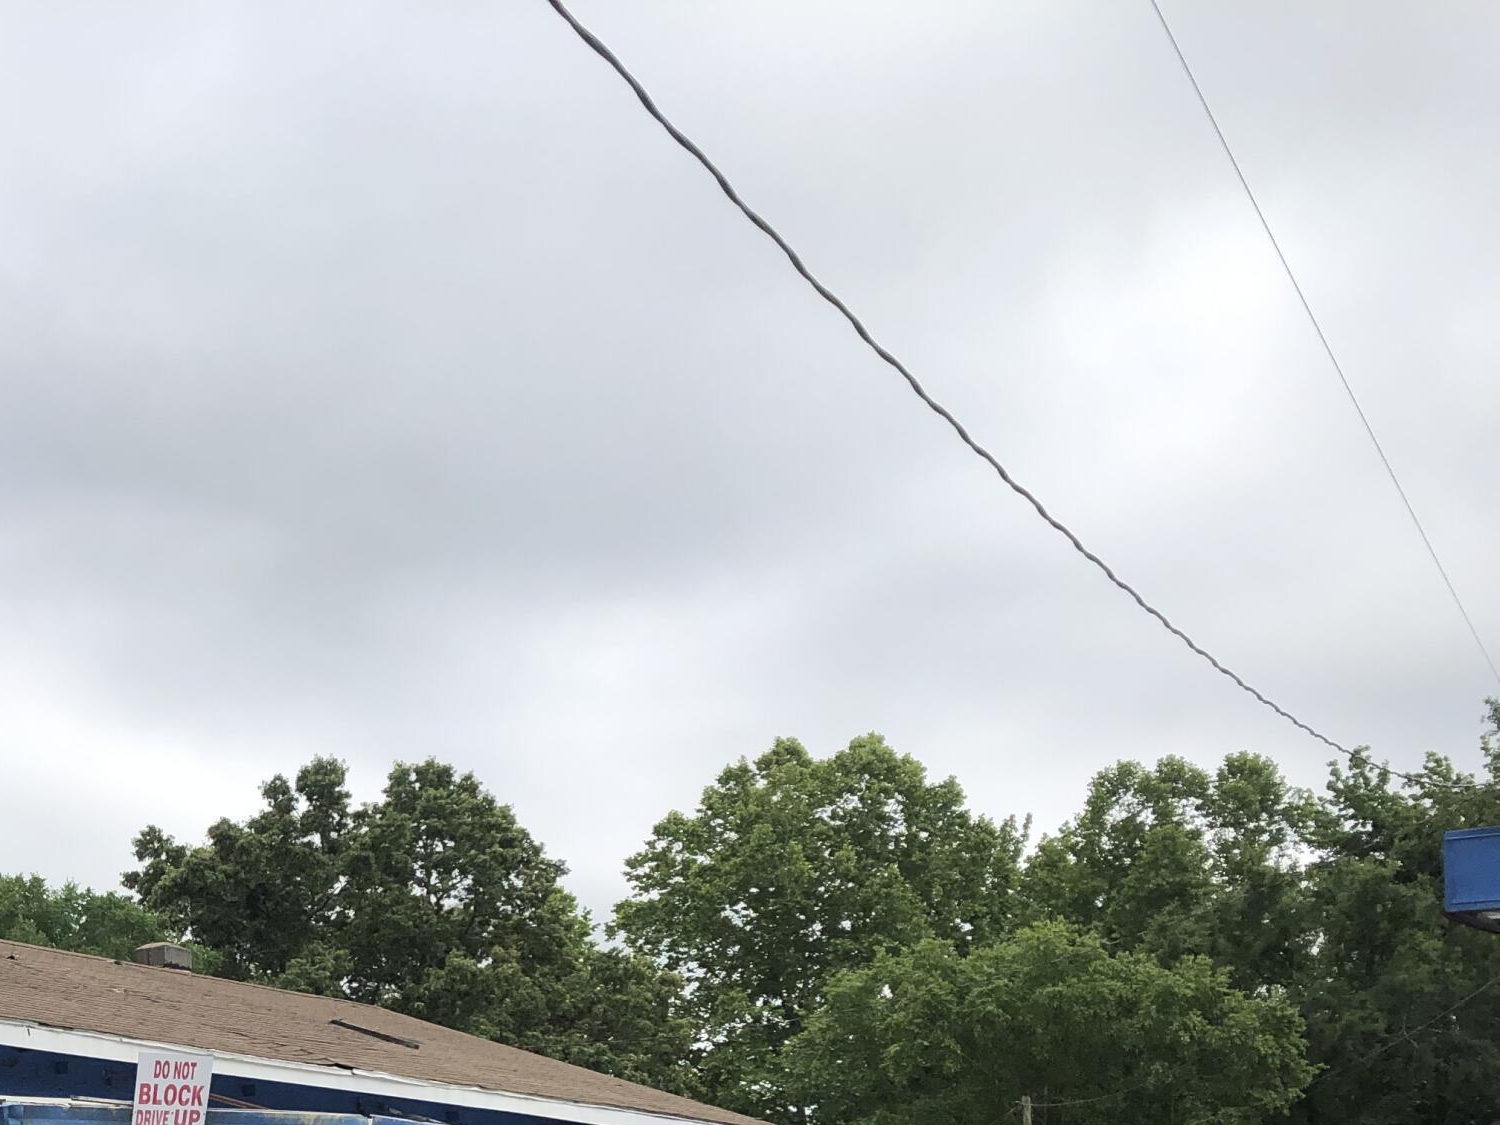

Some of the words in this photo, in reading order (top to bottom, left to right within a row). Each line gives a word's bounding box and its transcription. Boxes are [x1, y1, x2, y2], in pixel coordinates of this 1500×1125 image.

[153, 1060, 171, 1079] DO
[173, 1061, 198, 1081] NOT
[138, 1082, 205, 1107] BLOCK
